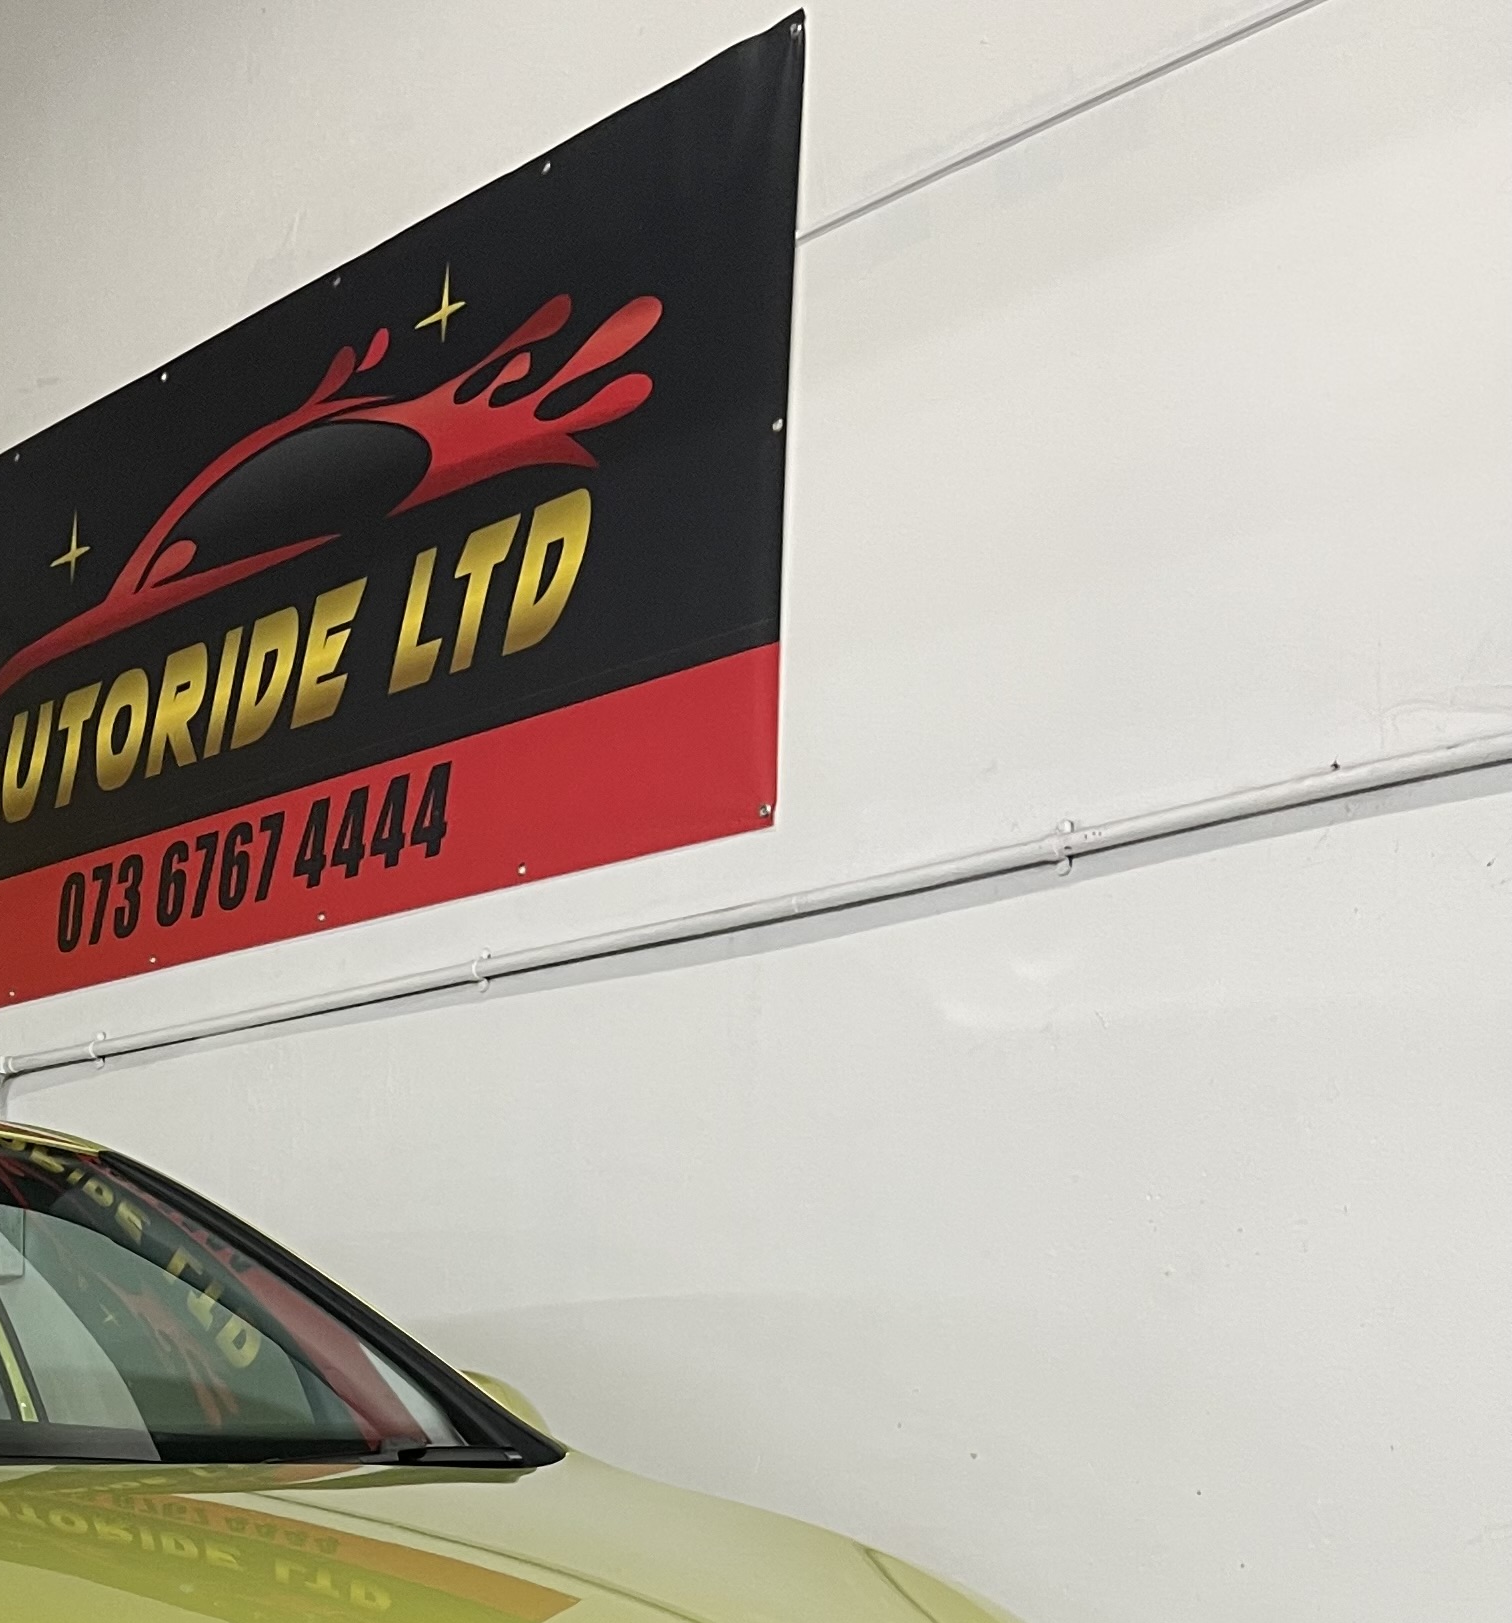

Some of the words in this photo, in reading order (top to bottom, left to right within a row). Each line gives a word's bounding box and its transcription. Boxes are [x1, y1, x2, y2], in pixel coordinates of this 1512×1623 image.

[389, 487, 592, 694] LTD
[57, 852, 143, 953] 073
[157, 811, 285, 928] 6767
[294, 762, 452, 889] 4444
